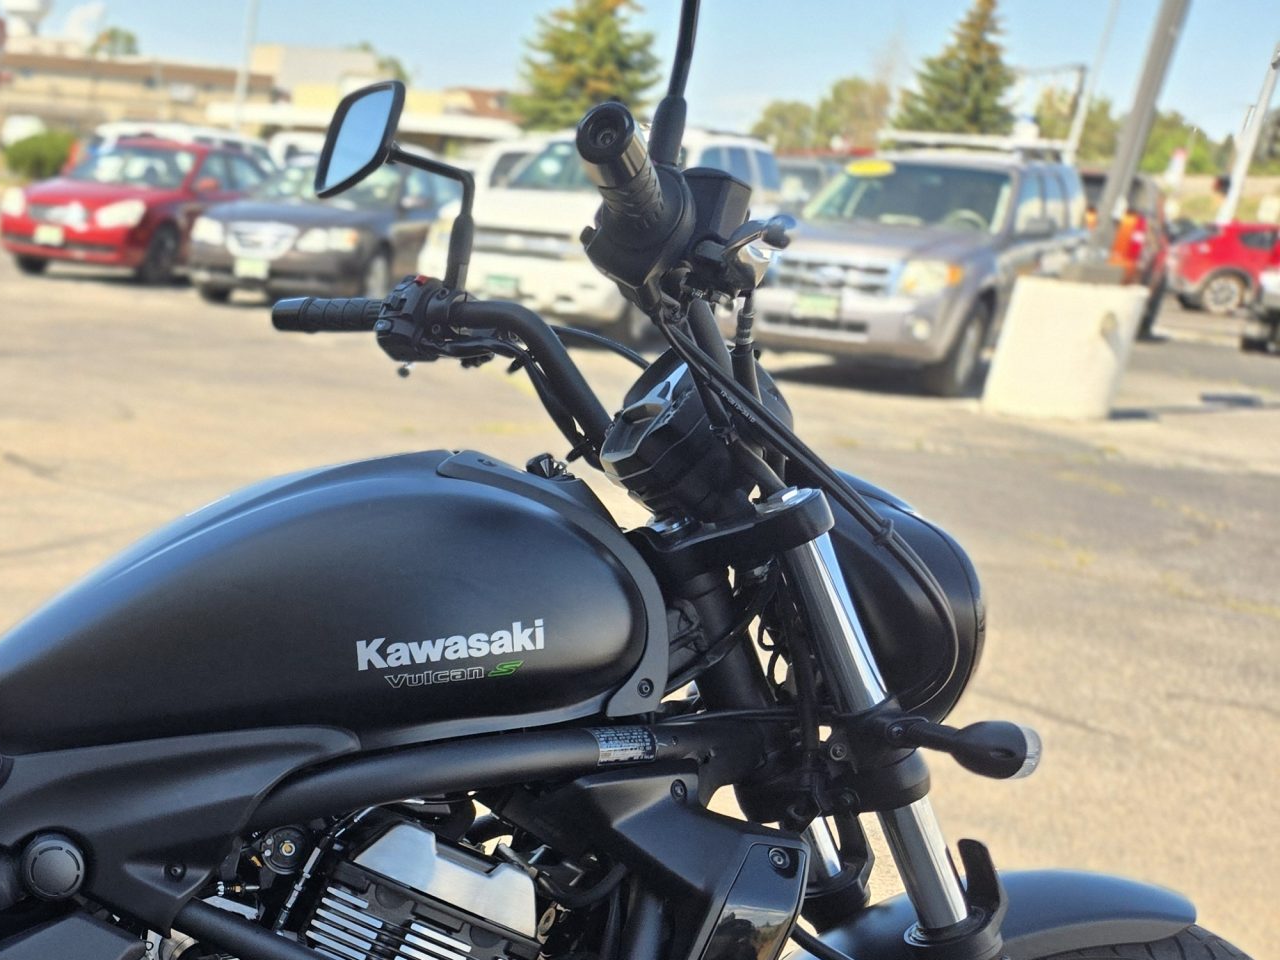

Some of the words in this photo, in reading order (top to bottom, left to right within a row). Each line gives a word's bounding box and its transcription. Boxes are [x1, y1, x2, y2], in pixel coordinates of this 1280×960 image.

[356, 619, 545, 671] Kawasaki
[384, 666, 484, 688] Vulcan
[488, 660, 524, 677] S
